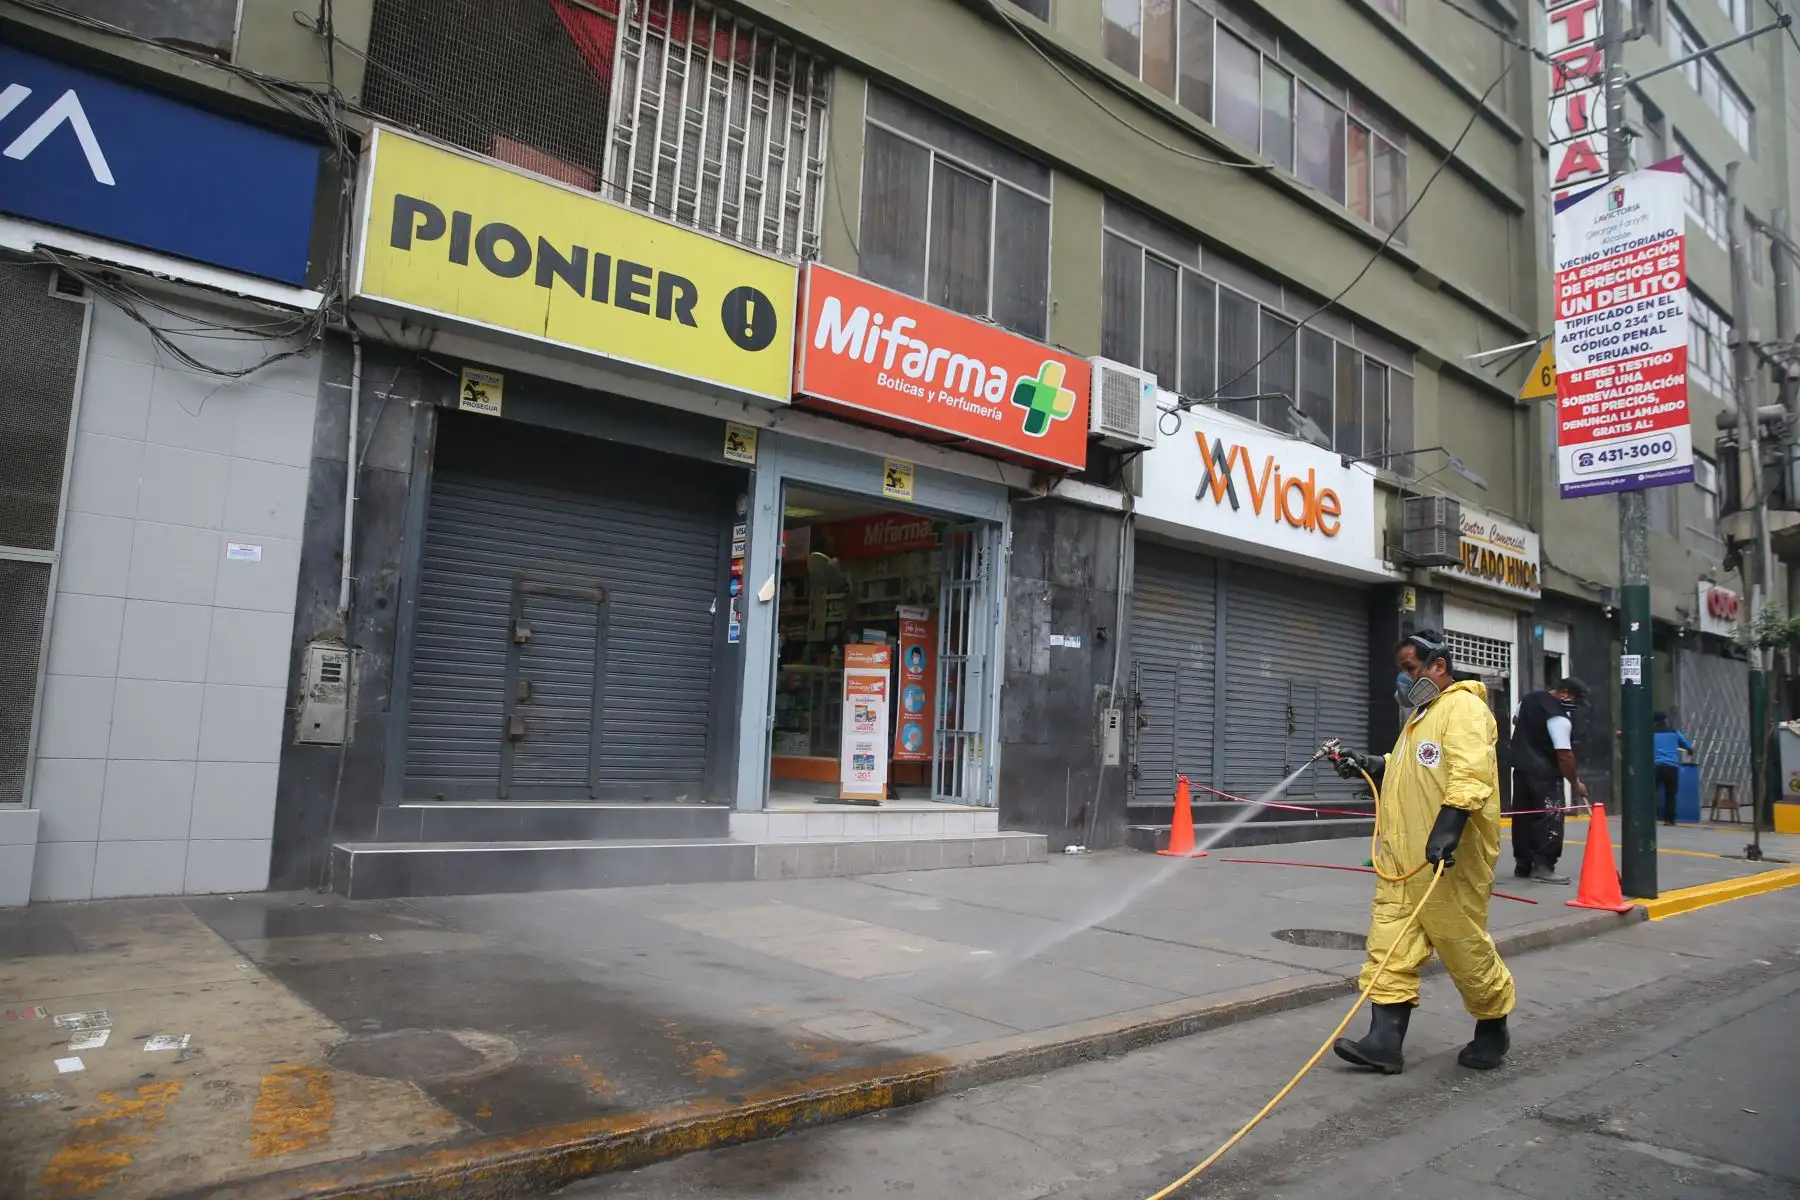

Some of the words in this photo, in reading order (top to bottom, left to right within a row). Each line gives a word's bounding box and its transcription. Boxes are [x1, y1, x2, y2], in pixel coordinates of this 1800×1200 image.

[390, 193, 699, 328] PIONIER
[1560, 252, 1599, 269] VECINO
[1603, 228, 1678, 256] VICTORIANO,
[1561, 272, 1576, 284] LA
[1580, 240, 1680, 277] ESPECULACIÓN
[1561, 285, 1580, 298] DE
[1584, 262, 1654, 292] PRECIOS
[1657, 254, 1680, 268] ES
[1561, 294, 1593, 317] UN
[1597, 271, 1680, 308] DELITO
[1561, 319, 1621, 344] ARTÍCULO
[1657, 307, 1683, 320] DEL
[1565, 306, 1633, 330] TIPIFICADO
[1637, 299, 1655, 312] EN
[1658, 295, 1675, 306] EL
[814, 296, 1008, 403] Mifarma
[1572, 333, 1620, 354] CÓDIGO
[1623, 324, 1667, 343] PENAL
[1588, 342, 1653, 364] PERUANO.
[1571, 372, 1582, 383] SI
[1584, 366, 1615, 381] ERES
[1618, 352, 1673, 372] TESTIGO
[1596, 379, 1612, 390] DE
[1615, 373, 1644, 386] UNA
[462, 401, 498, 413] PROSEGUR
[877, 373, 925, 398] Boticas
[927, 389, 935, 403] y
[938, 390, 1002, 421] Perfumería
[1562, 374, 1685, 408] SOBREVALORACIÓN
[1582, 404, 1599, 416] DE
[1602, 393, 1660, 413] PRECIOS,
[1562, 412, 1618, 431] DENUNCIA
[1620, 400, 1686, 421] LLAMANDO
[1592, 424, 1632, 437] GRATIS
[1635, 420, 1653, 430] AL:
[1598, 440, 1673, 463] 431-3000
[1240, 446, 1342, 537] Viale
[863, 519, 930, 547] Mifarma
[1489, 523, 1526, 550] Comercial
